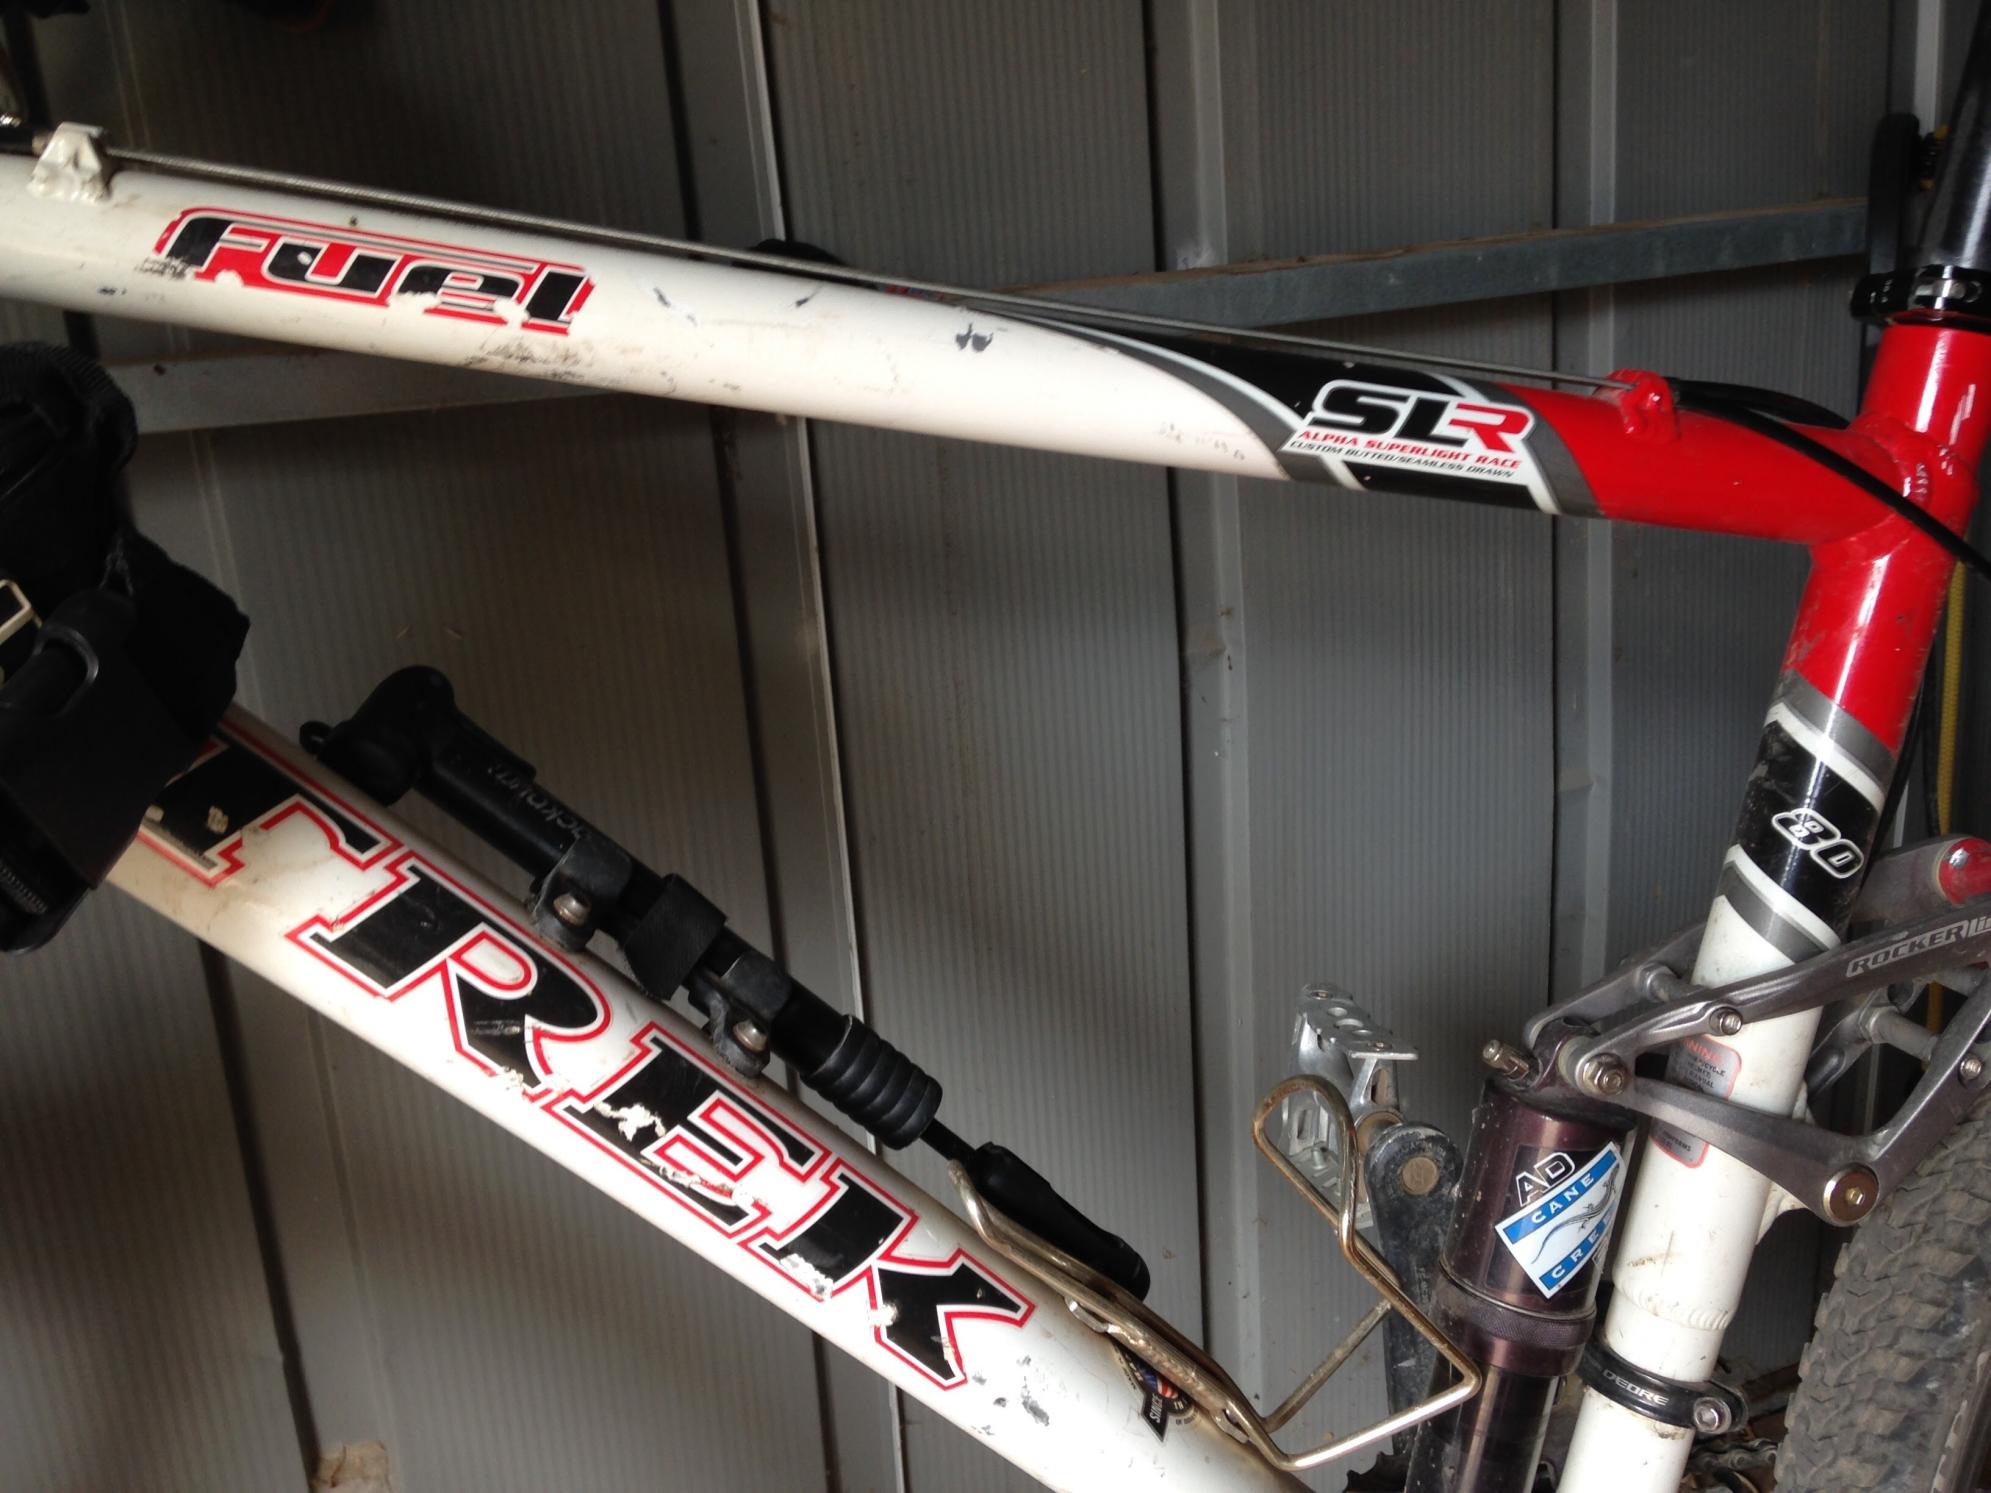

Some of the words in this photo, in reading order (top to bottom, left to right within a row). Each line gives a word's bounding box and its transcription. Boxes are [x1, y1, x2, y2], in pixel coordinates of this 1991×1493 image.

[1306, 384, 1531, 454] SLR
[1289, 440, 1343, 455] CUSTOM
[1466, 465, 1516, 479] DRAWN
[1298, 430, 1359, 447] ALPHA
[1364, 438, 1471, 462] SUPERLIGHT
[1475, 453, 1522, 470] RACE
[1771, 808, 1864, 879] 80
[1531, 1173, 1594, 1225] CANE
[1603, 1368, 1670, 1406] DEORE
